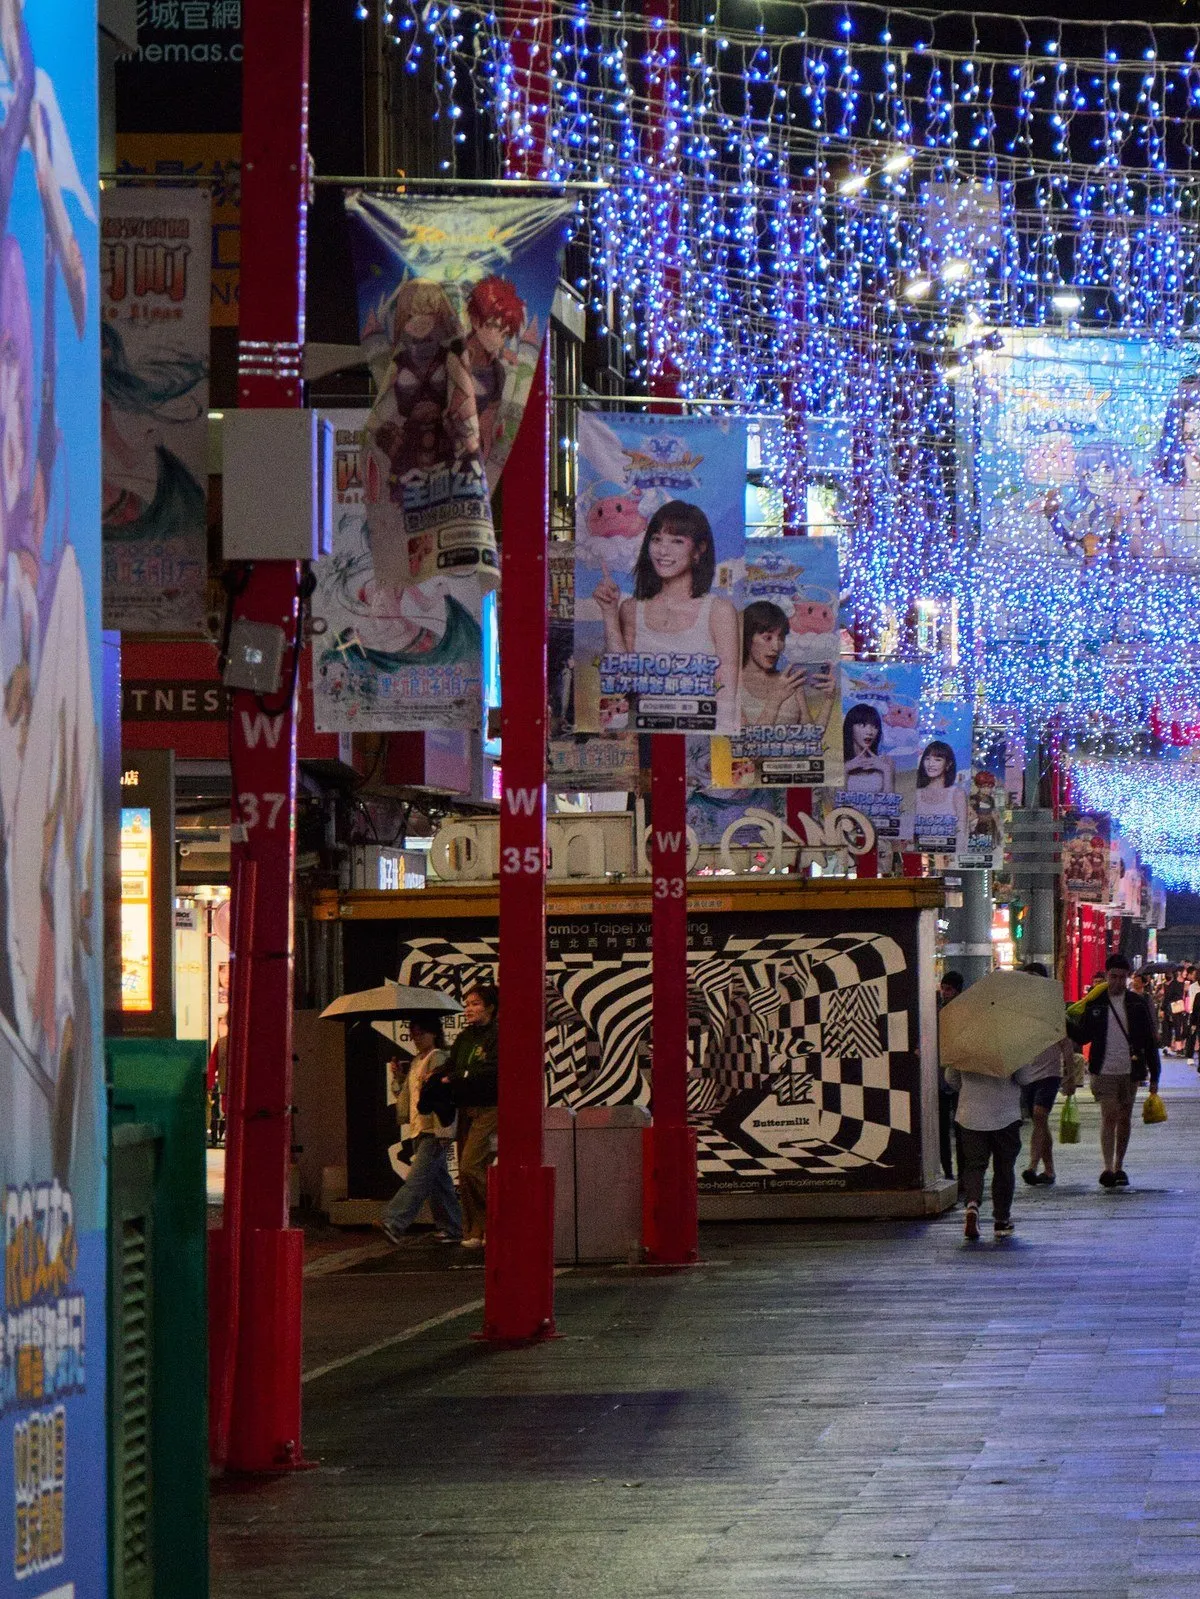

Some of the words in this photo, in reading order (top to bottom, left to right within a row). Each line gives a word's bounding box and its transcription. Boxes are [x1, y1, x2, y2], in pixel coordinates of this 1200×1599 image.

[241, 711, 284, 748] W
[237, 792, 286, 829] 37
[508, 787, 543, 817] W
[655, 831, 682, 854] W
[503, 846, 542, 875] 35
[654, 879, 684, 899] 33
[753, 1117, 810, 1128] Buttermilk
